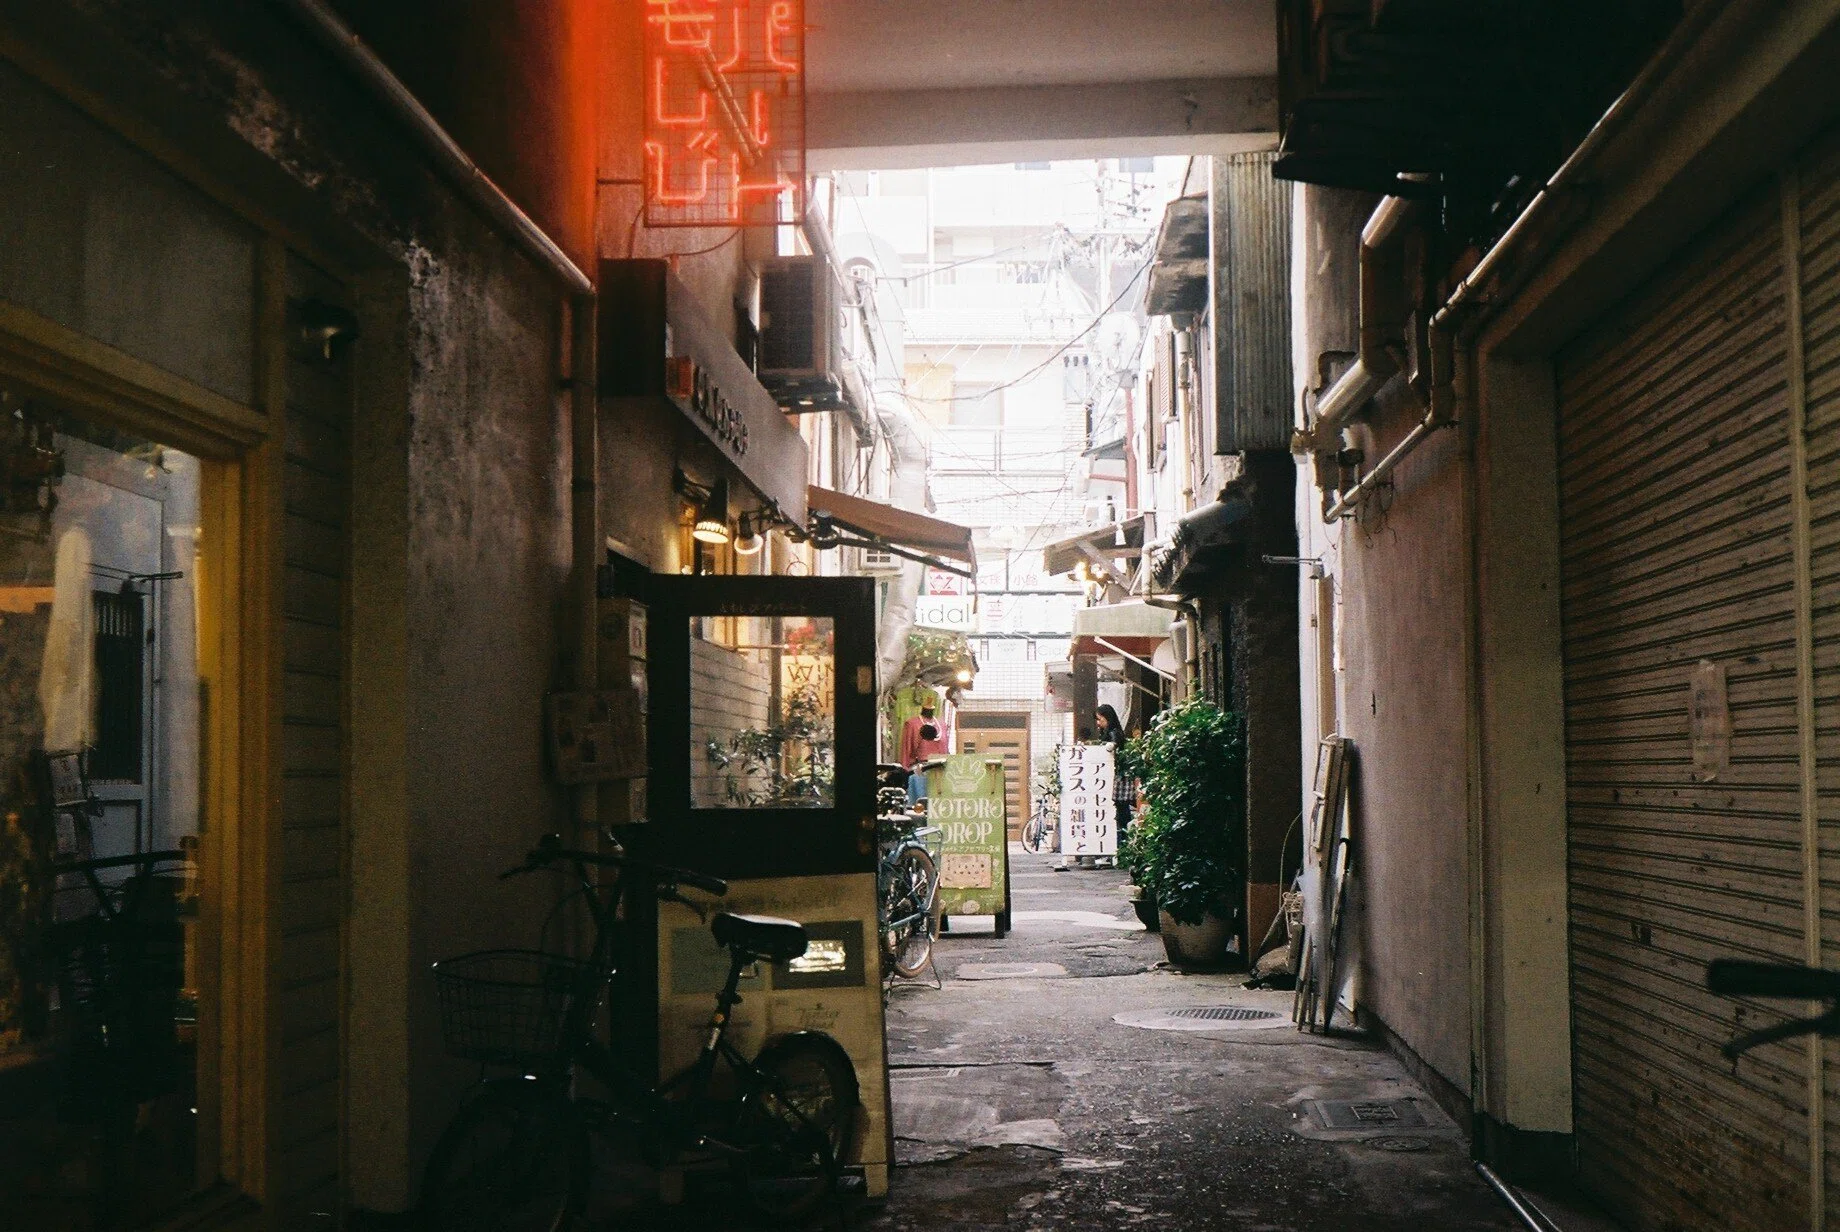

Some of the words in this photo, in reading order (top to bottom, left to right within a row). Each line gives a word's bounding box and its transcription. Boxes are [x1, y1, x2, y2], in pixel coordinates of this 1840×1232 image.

[915, 603, 970, 624] idal
[927, 797, 1004, 819] KOTORO
[938, 821, 993, 845] DROP
